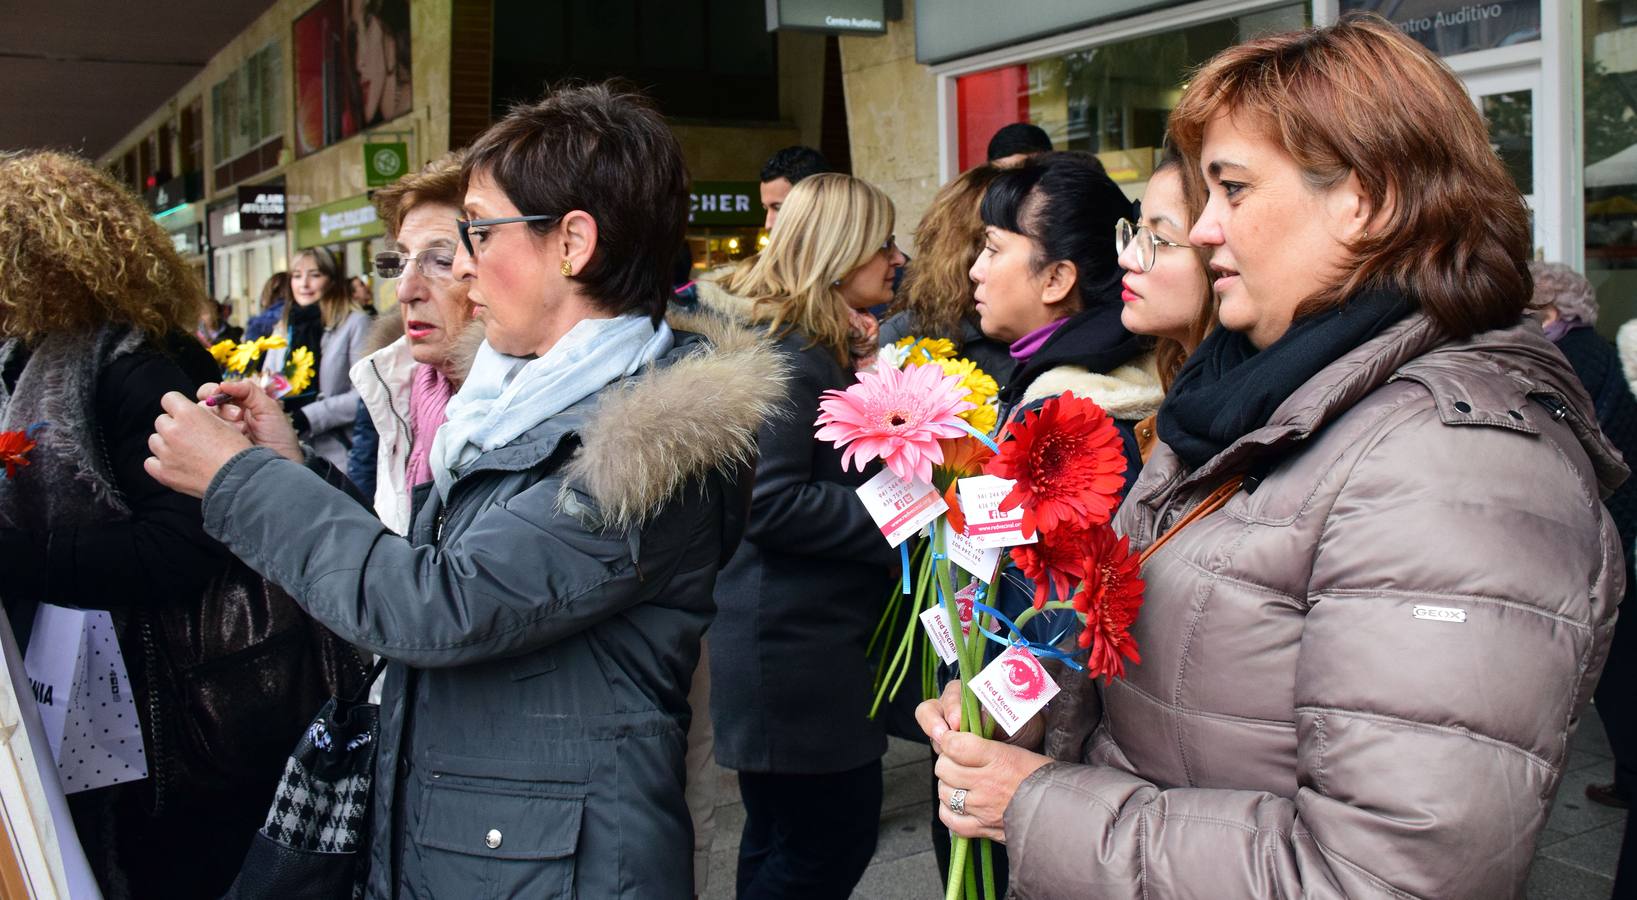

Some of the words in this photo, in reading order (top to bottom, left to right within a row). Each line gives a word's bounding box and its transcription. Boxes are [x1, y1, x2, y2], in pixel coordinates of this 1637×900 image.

[825, 15, 850, 26] Centro
[852, 17, 882, 28] Auditivo
[1434, 4, 1502, 29] Auditivo
[978, 522, 1022, 531] www.redvecinal.or
[1415, 608, 1461, 619] GEOX
[934, 615, 945, 630] Red
[29, 678, 53, 706] NIA
[984, 680, 998, 696] Red
[997, 695, 1019, 722] Vecinal
